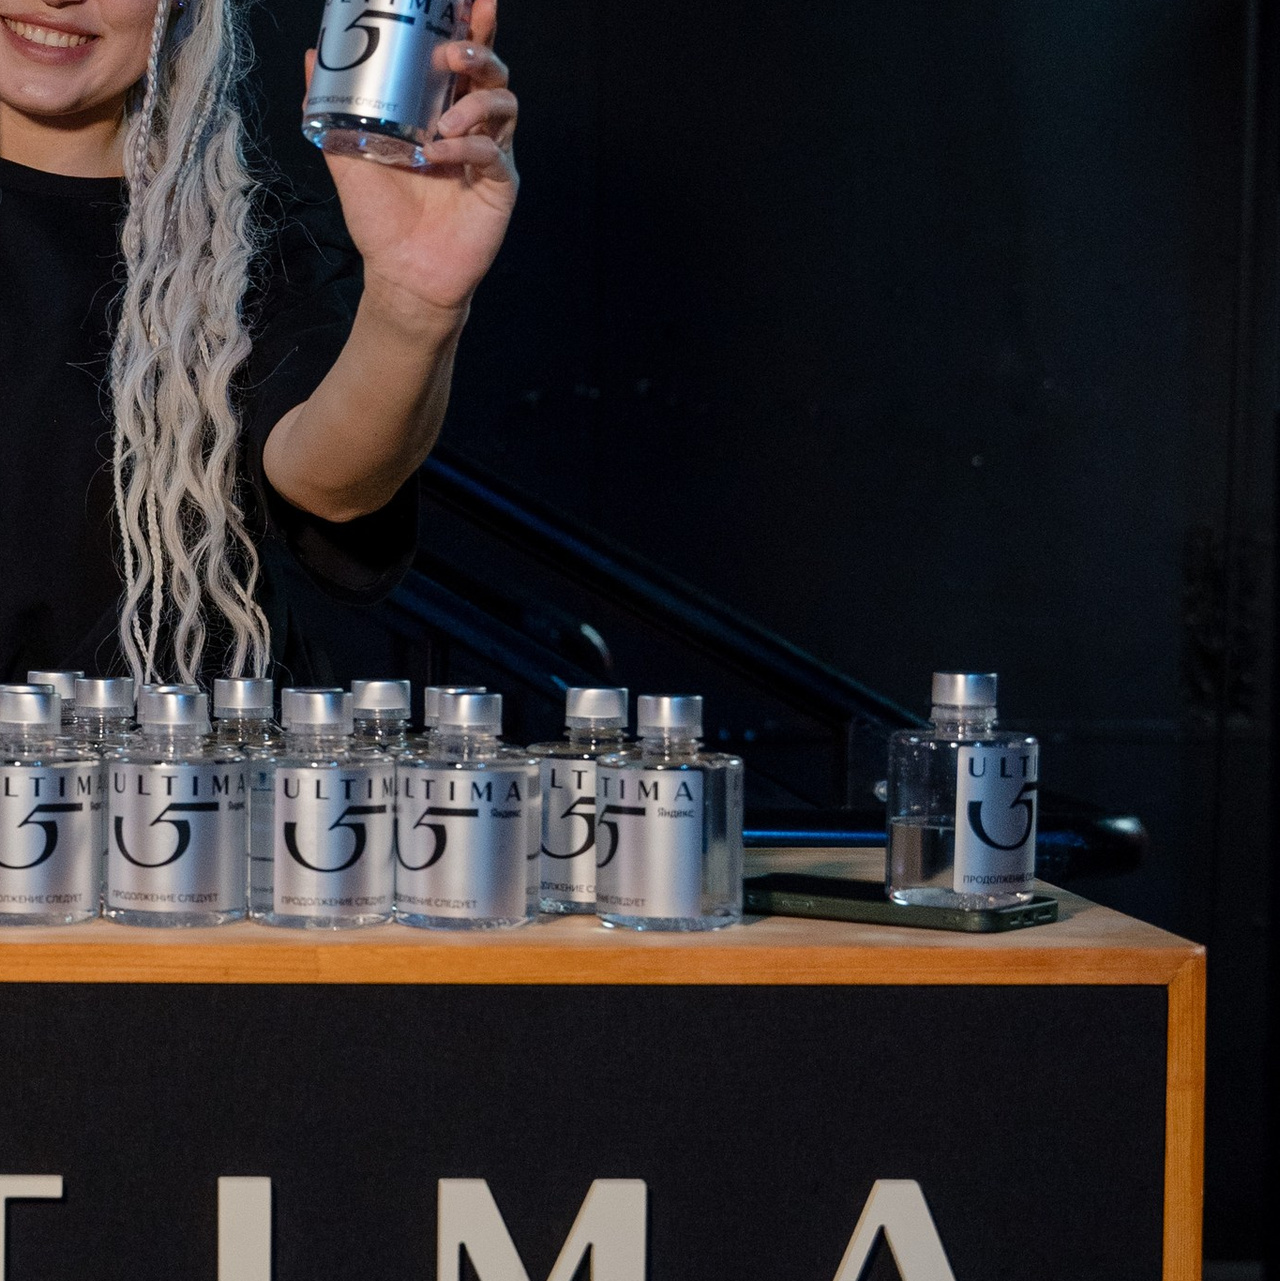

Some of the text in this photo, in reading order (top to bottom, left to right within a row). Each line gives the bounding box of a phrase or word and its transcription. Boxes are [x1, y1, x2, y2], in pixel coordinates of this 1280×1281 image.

[114, 773, 245, 797] ULTIMA
[283, 778, 394, 800] ULTIM
[405, 778, 522, 802] LTIMA
[658, 807, 695, 818] Яндекс
[45, 893, 83, 905] СЛЕДУЕТ
[112, 890, 218, 904] ПРОДОЛЖЕНИЕ СЛЕДУЕТ
[281, 896, 387, 908] ПРОДОЛЖЕНИЕ СЛЕДУЕТ
[608, 895, 646, 907] СЛЕДУЕТ
[435, 899, 477, 909] СЛЕДУЕТ
